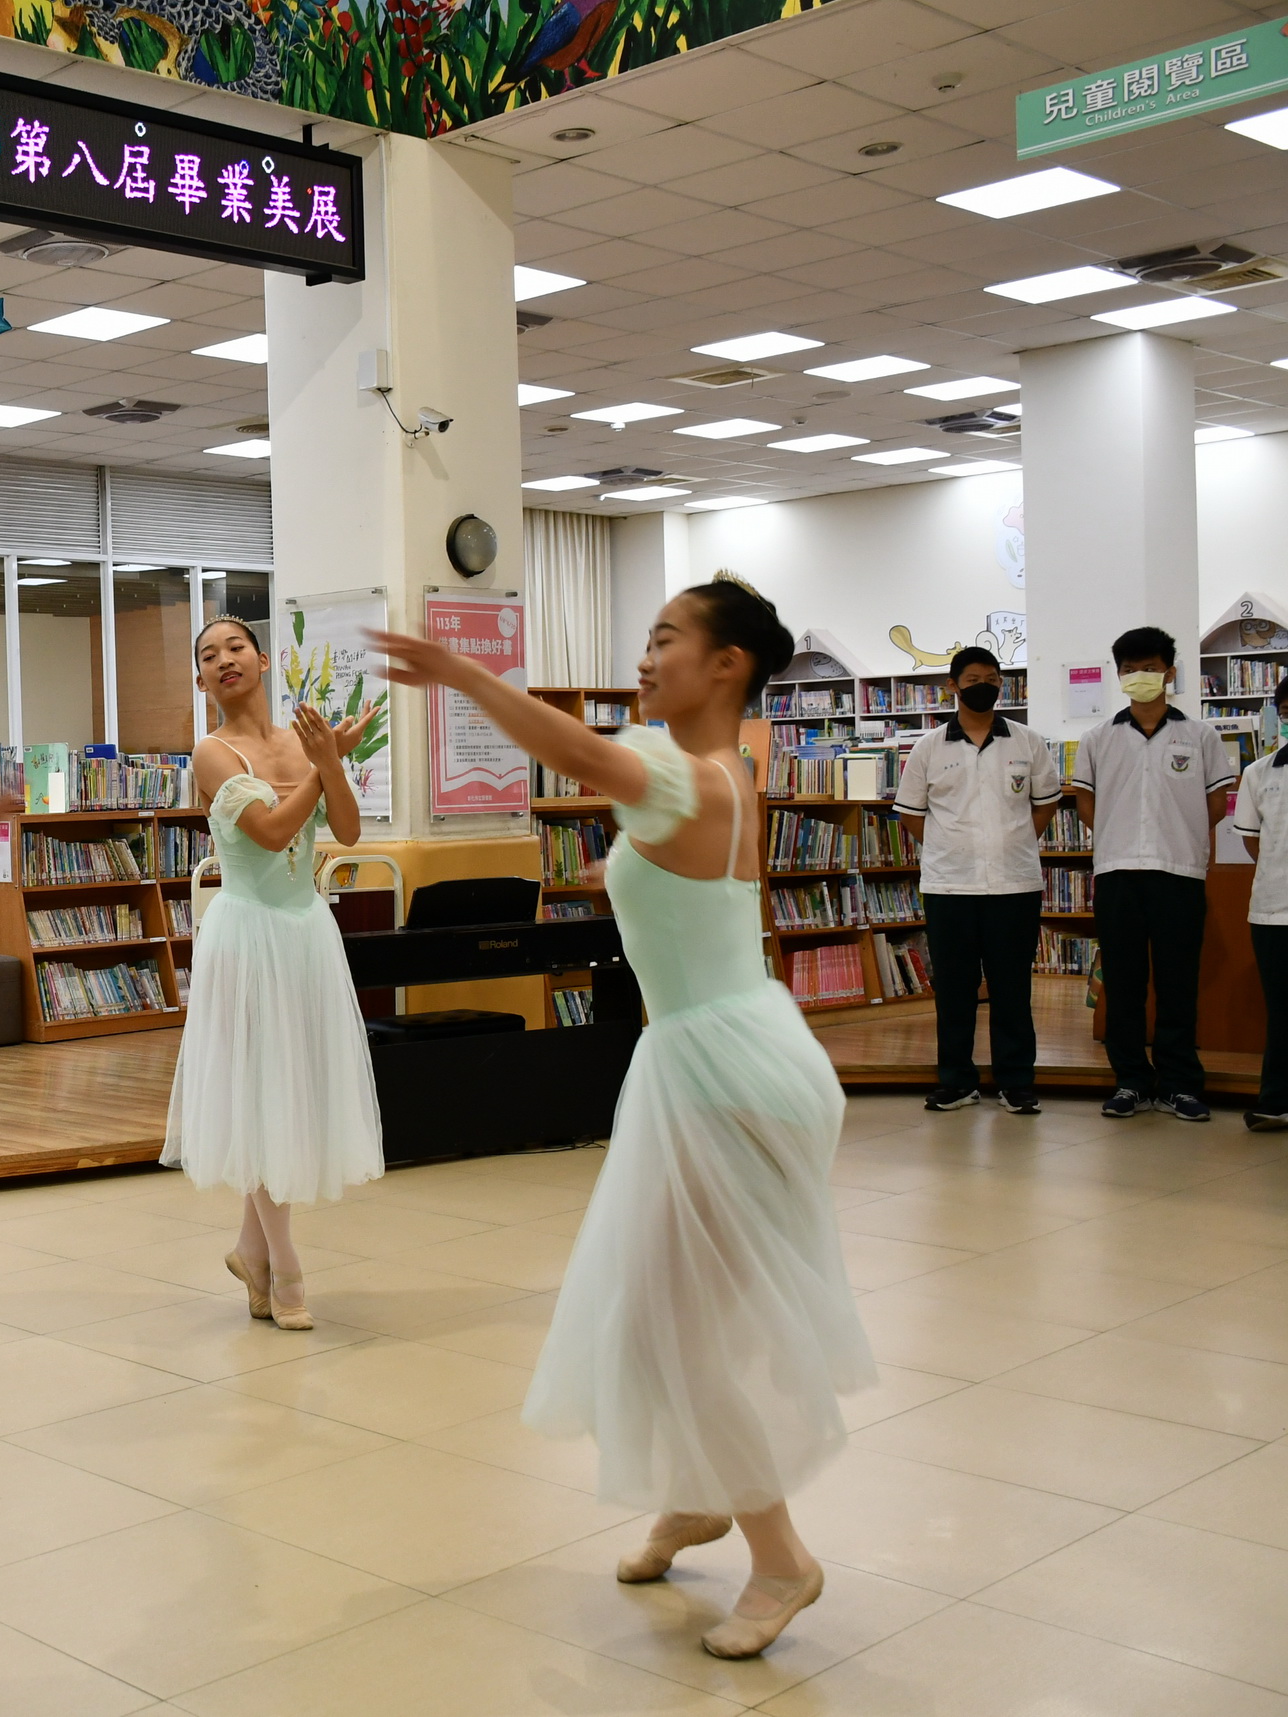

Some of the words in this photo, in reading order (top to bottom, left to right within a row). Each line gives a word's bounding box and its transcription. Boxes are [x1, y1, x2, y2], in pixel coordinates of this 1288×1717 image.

[1043, 38, 1249, 125] 兒童閱覽區
[1085, 99, 1156, 127] Children's
[1165, 88, 1200, 105] Area
[1240, 600, 1253, 617] 2
[436, 615, 461, 631] 113年
[804, 635, 812, 651] 1
[490, 939, 518, 949] Roland
